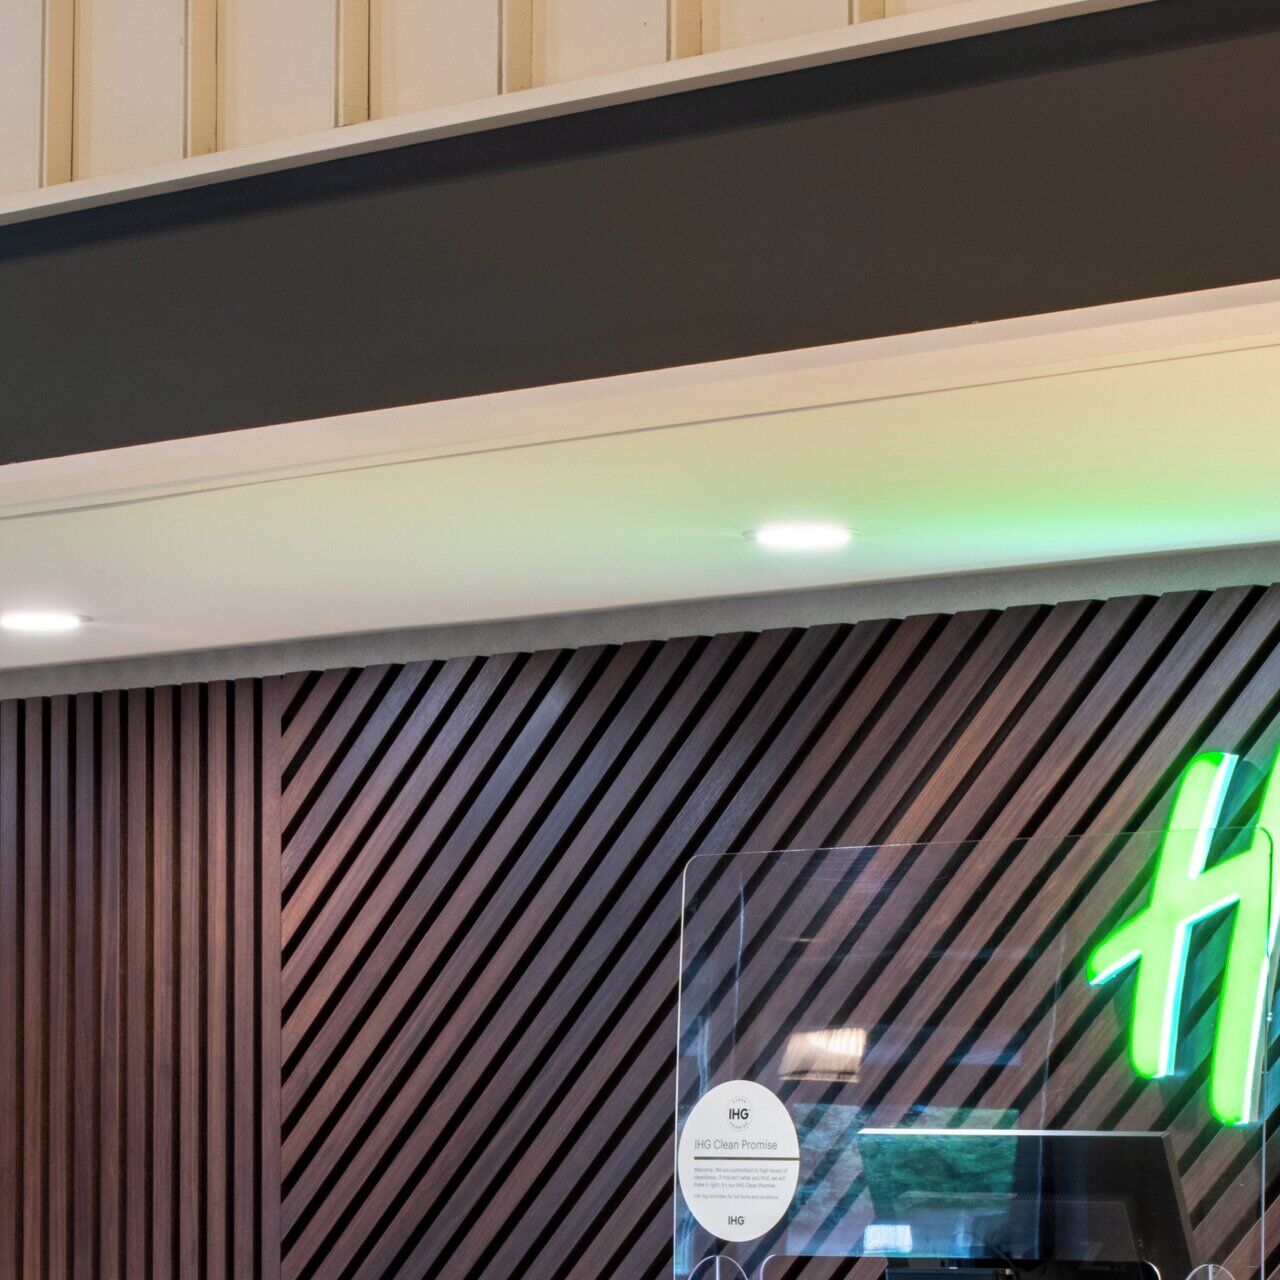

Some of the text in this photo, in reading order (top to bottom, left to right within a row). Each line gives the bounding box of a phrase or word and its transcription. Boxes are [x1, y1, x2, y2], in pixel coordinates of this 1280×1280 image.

[729, 1108, 749, 1120] IHG
[694, 1139, 778, 1151] IHG Clean Promise
[728, 1216, 745, 1226] IHG
